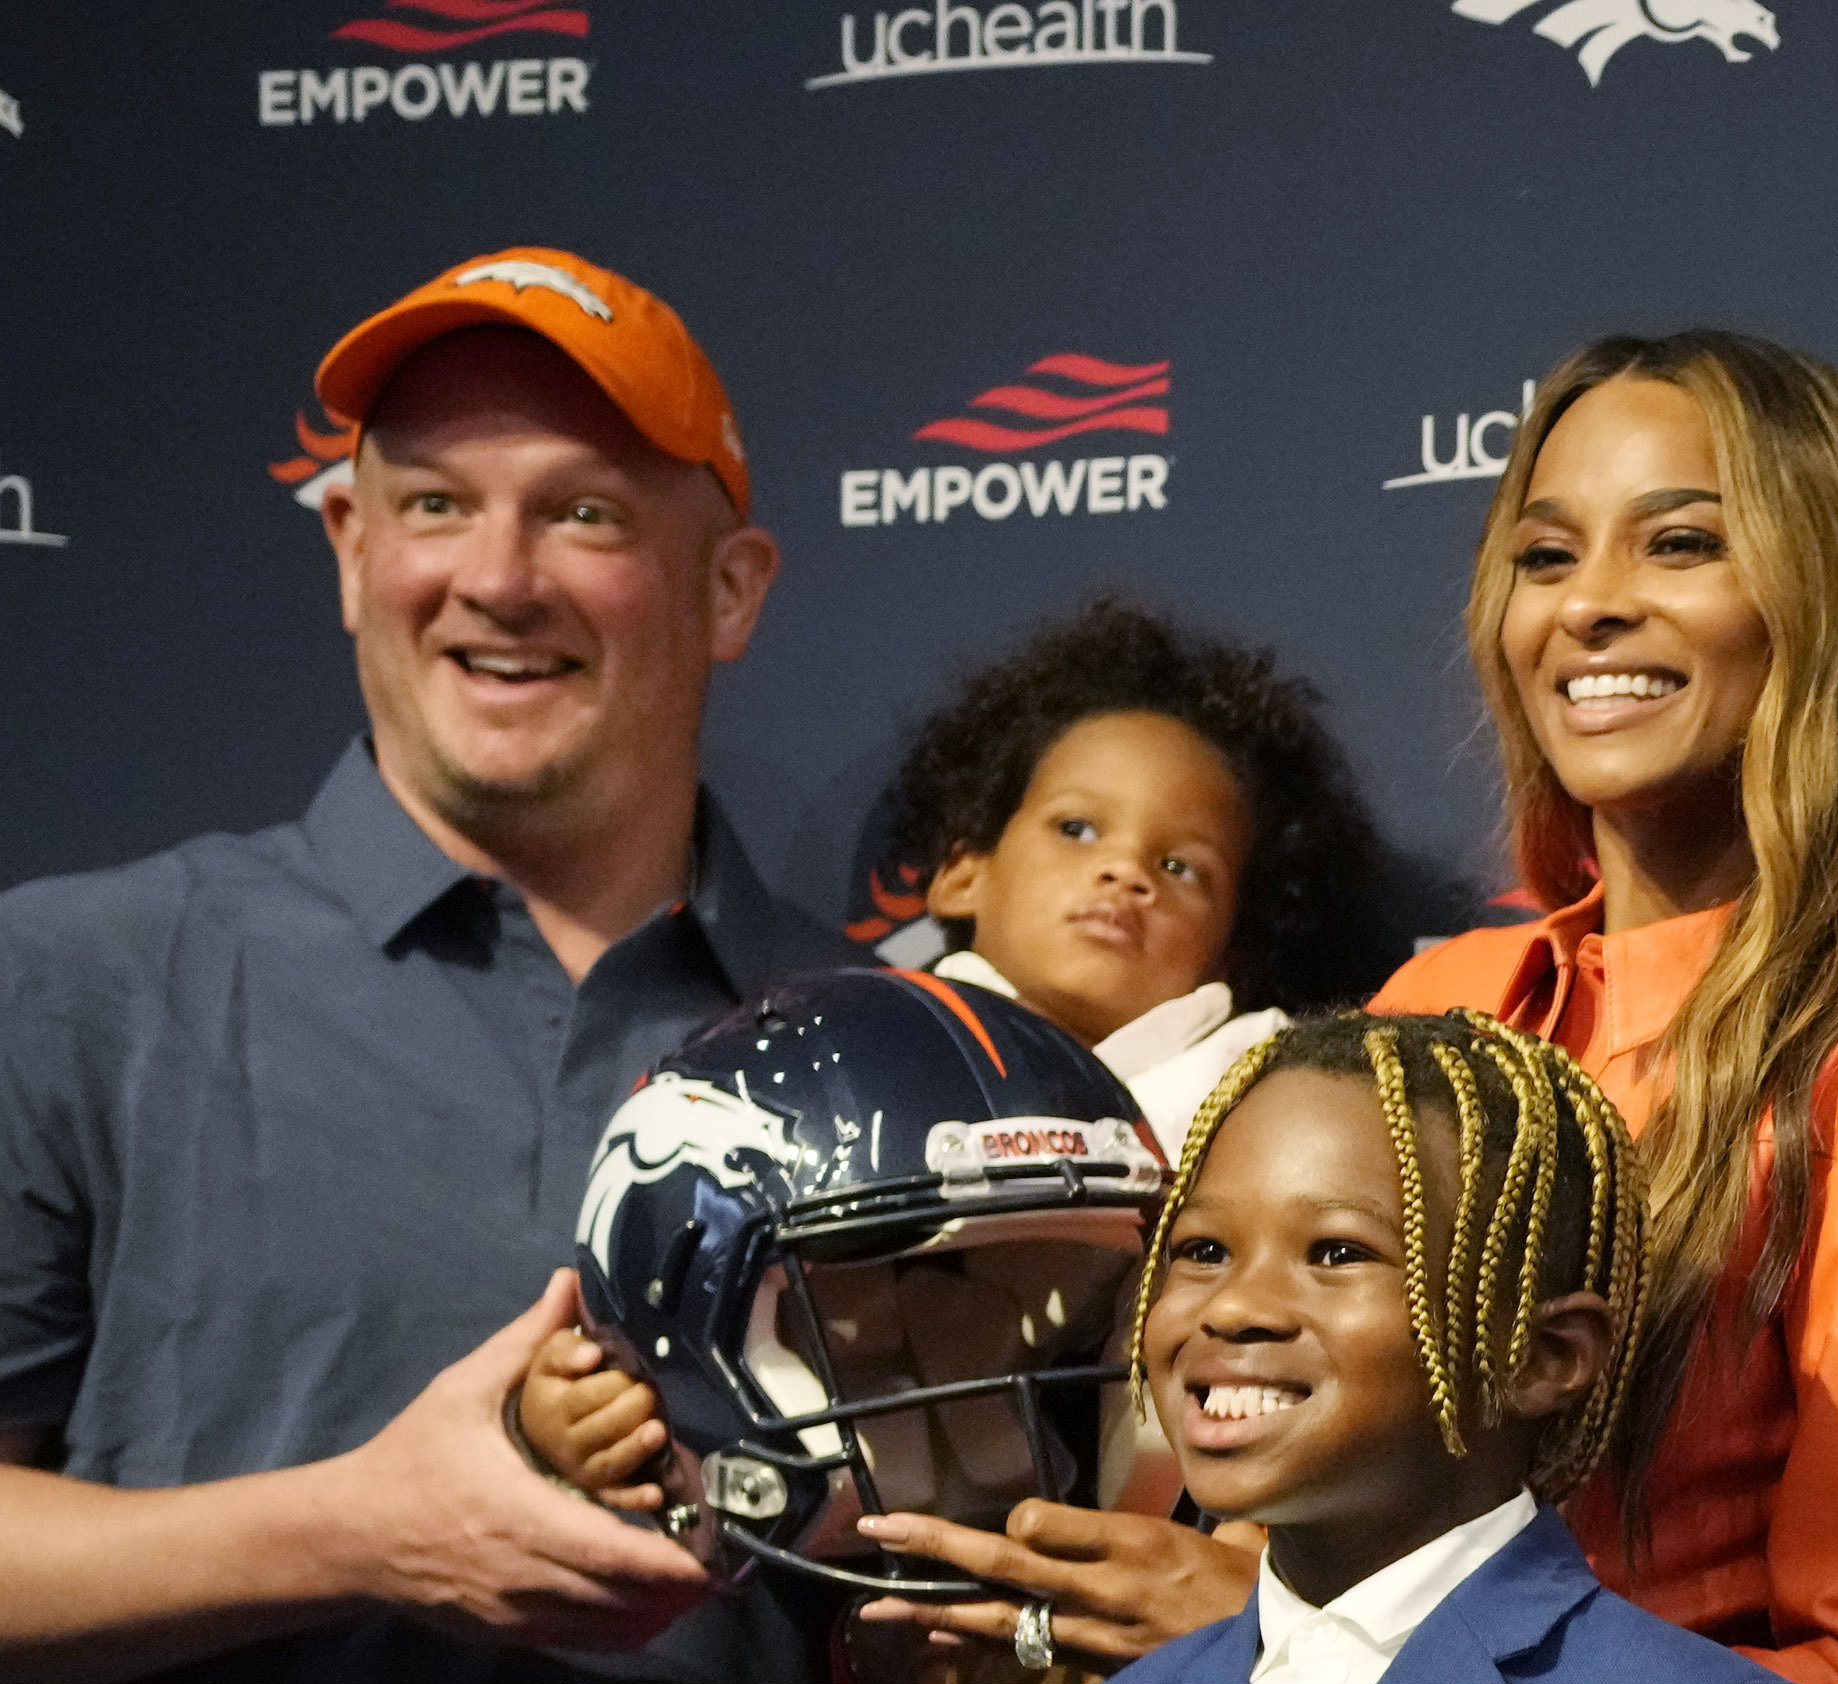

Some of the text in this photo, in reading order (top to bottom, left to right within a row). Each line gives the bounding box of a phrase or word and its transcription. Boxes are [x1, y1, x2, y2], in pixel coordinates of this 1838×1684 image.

[841, 0, 1177, 73] uchealth
[259, 58, 590, 127] EMPOWER
[841, 454, 1170, 528] EMPOWER
